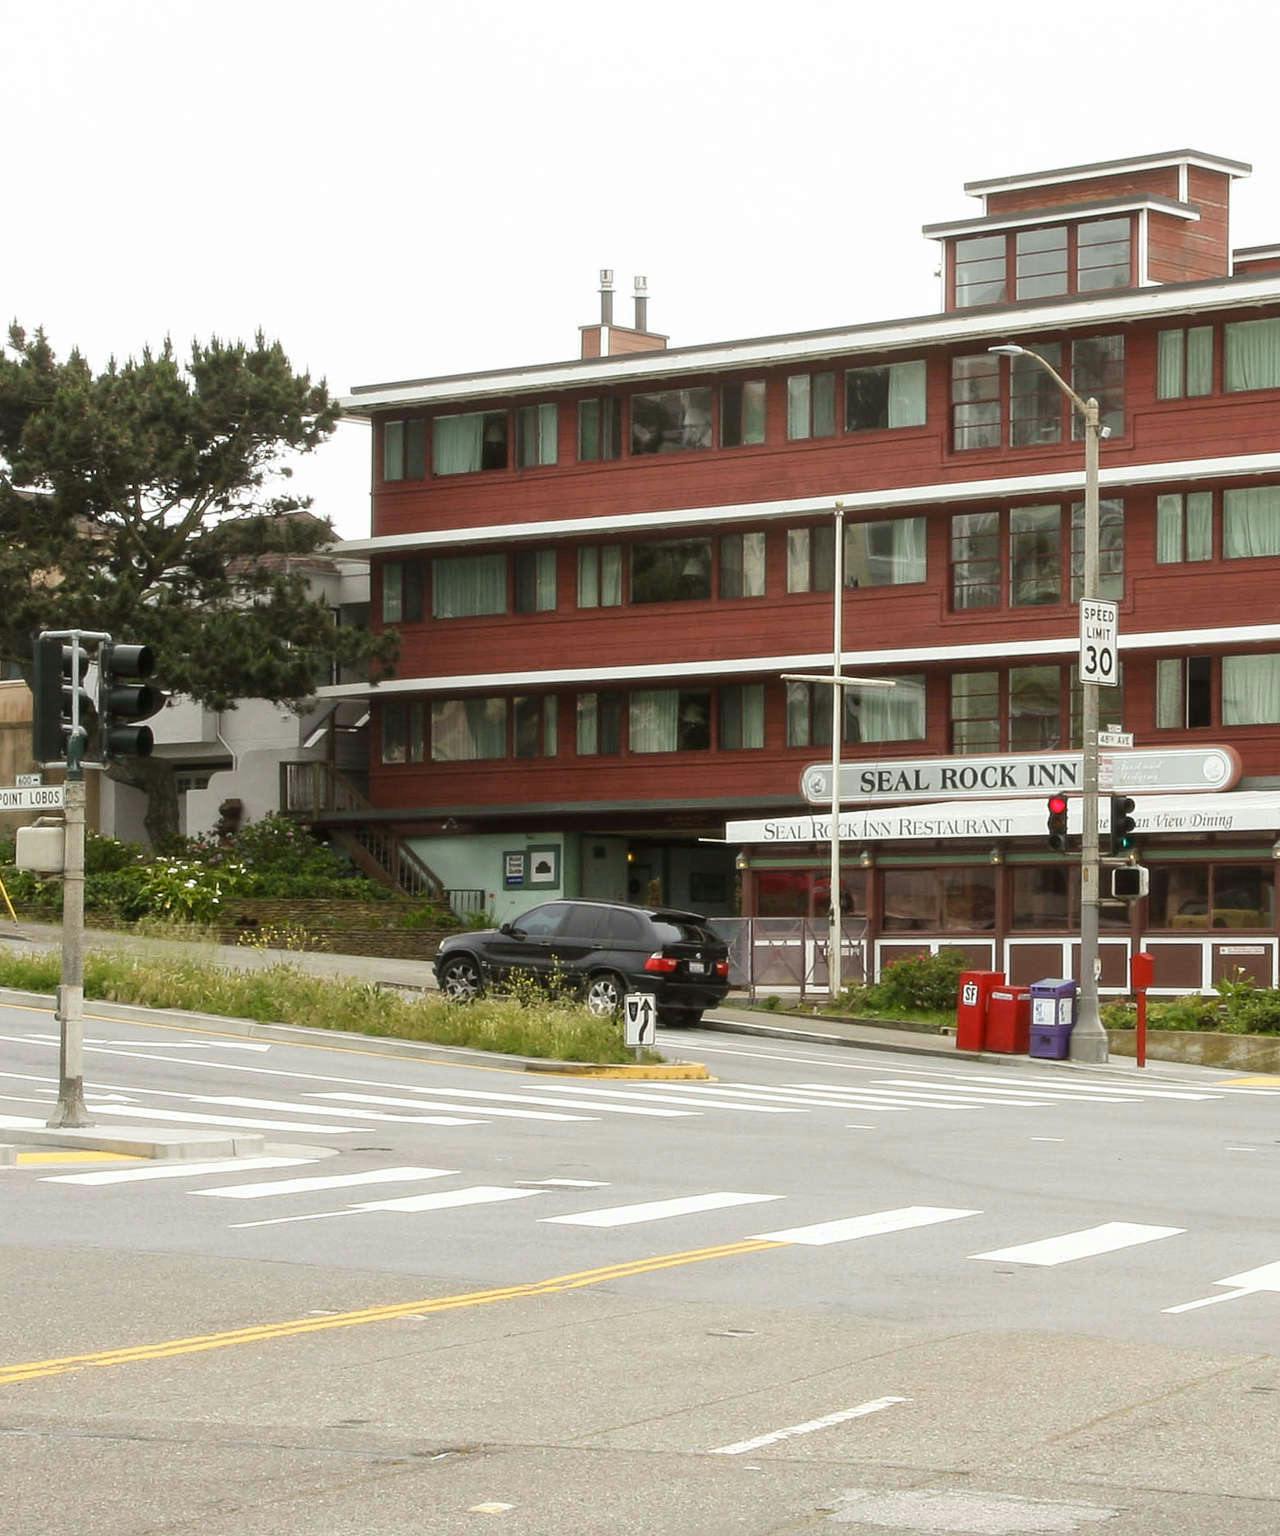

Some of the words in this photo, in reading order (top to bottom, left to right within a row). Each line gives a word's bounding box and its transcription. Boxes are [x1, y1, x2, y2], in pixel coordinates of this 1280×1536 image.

[1084, 607, 1114, 623] SPEED
[1086, 626, 1111, 641] LIMIT
[1085, 645, 1112, 676] 30
[859, 768, 931, 793] SEAL
[940, 764, 1017, 791] ROCK
[1027, 762, 1078, 787] INN
[30, 790, 60, 805] LOBOS
[763, 821, 807, 841] SEAL
[812, 820, 858, 840] ROCK
[864, 818, 893, 838] INN
[898, 817, 1014, 836] RESTAURANT
[1152, 813, 1186, 829] View
[1190, 812, 1233, 830] Dining
[965, 986, 977, 1002] SF
